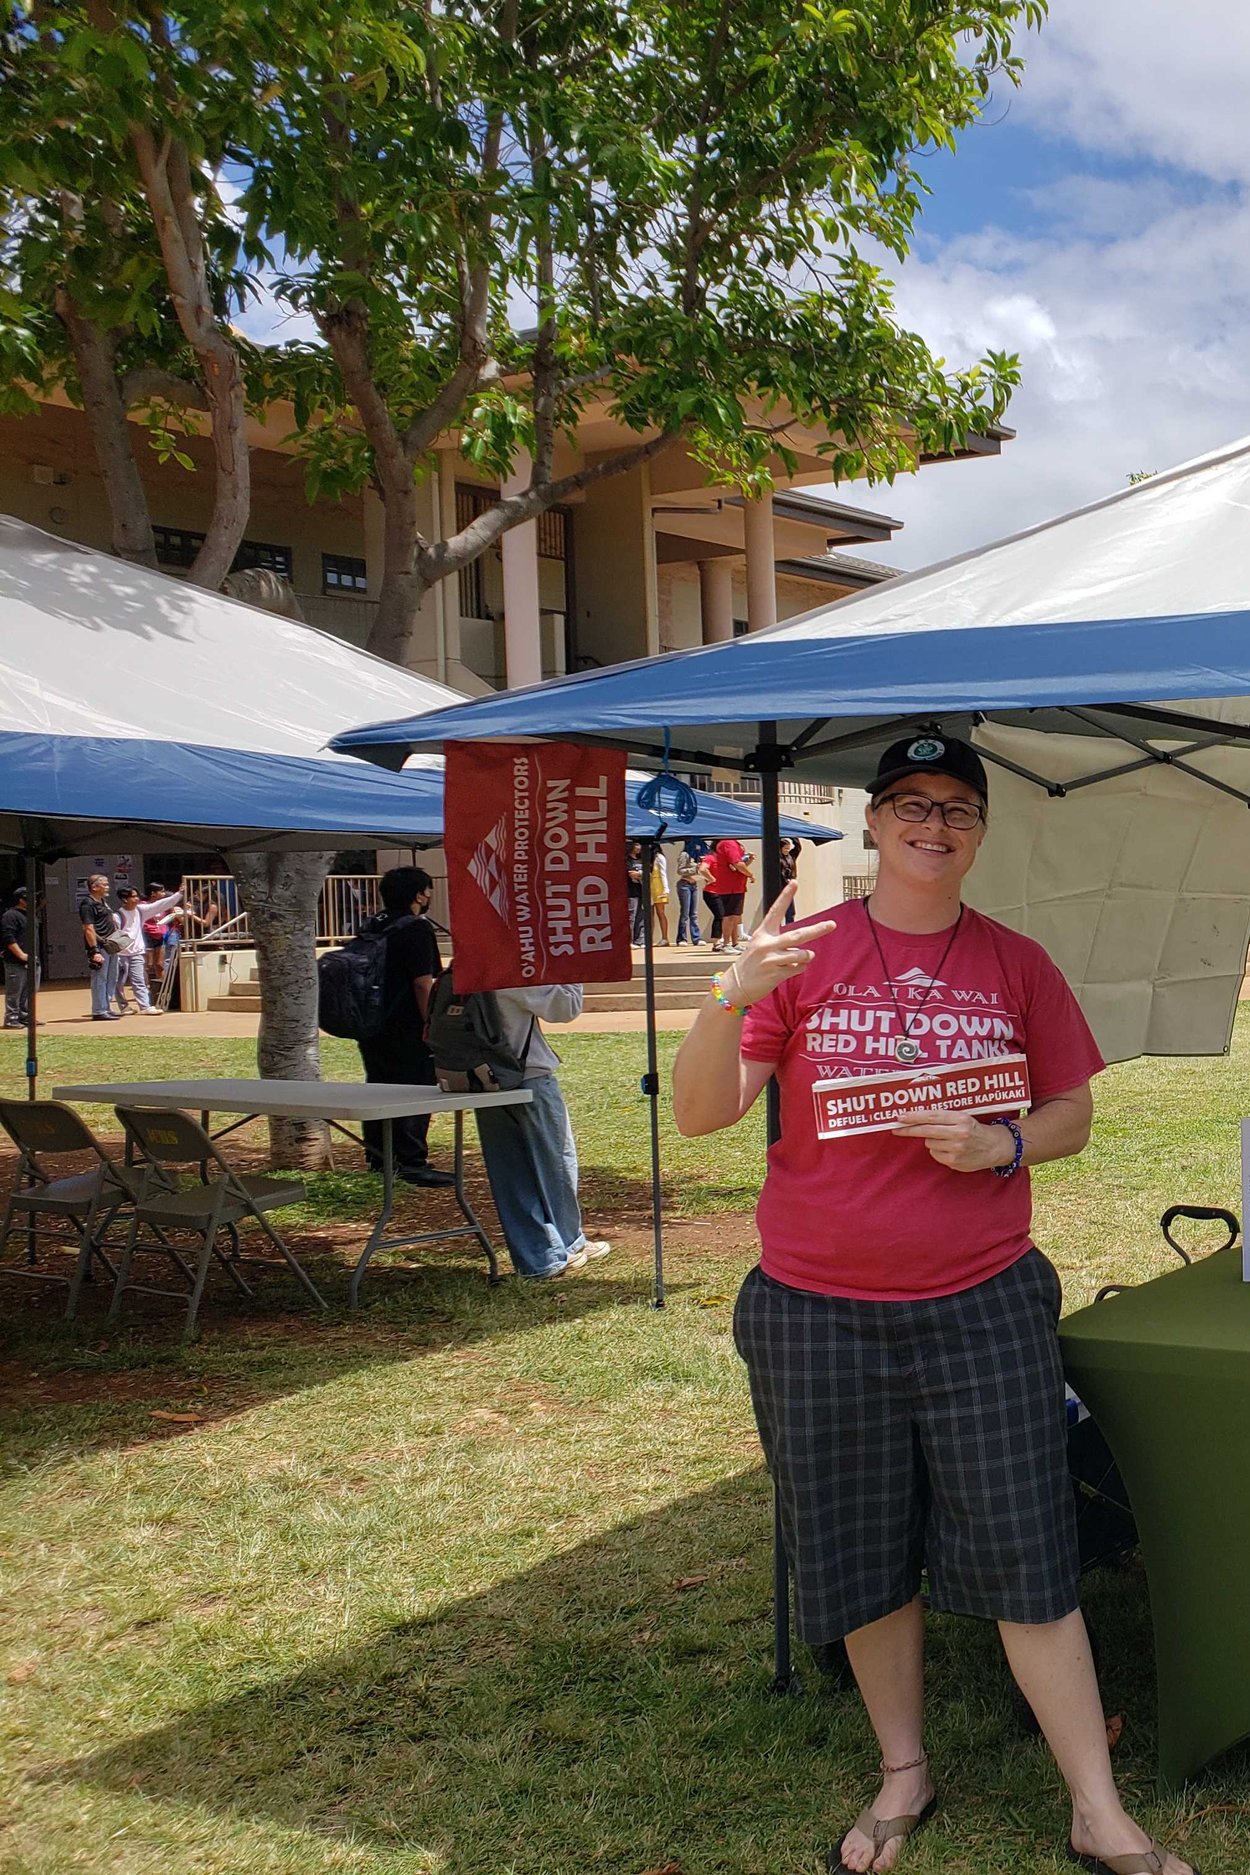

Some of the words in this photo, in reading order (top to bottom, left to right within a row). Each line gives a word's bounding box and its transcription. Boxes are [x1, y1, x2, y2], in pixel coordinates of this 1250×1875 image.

[513, 756, 530, 861] PROTECTORS
[543, 778, 571, 871] DOWN
[574, 775, 608, 863] HILL
[513, 863, 530, 922] WATER
[544, 880, 575, 956] SHUT
[576, 875, 613, 953] RED
[833, 982, 882, 998] OLA
[889, 986, 898, 999] I
[907, 987, 945, 1001] KA
[951, 989, 1000, 1005] WAI
[805, 1007, 896, 1033] SHUT
[904, 1012, 1015, 1041] DOWN
[805, 1032, 857, 1053] RED
[936, 1039, 1009, 1060] TANKS
[827, 1094, 876, 1116] SHUT
[880, 1083, 942, 1107] DOWN
[945, 1077, 981, 1097] RED
[984, 1071, 1024, 1091] HILL
[828, 1115, 869, 1129] DEFUEL
[931, 1097, 974, 1112] RESTORE
